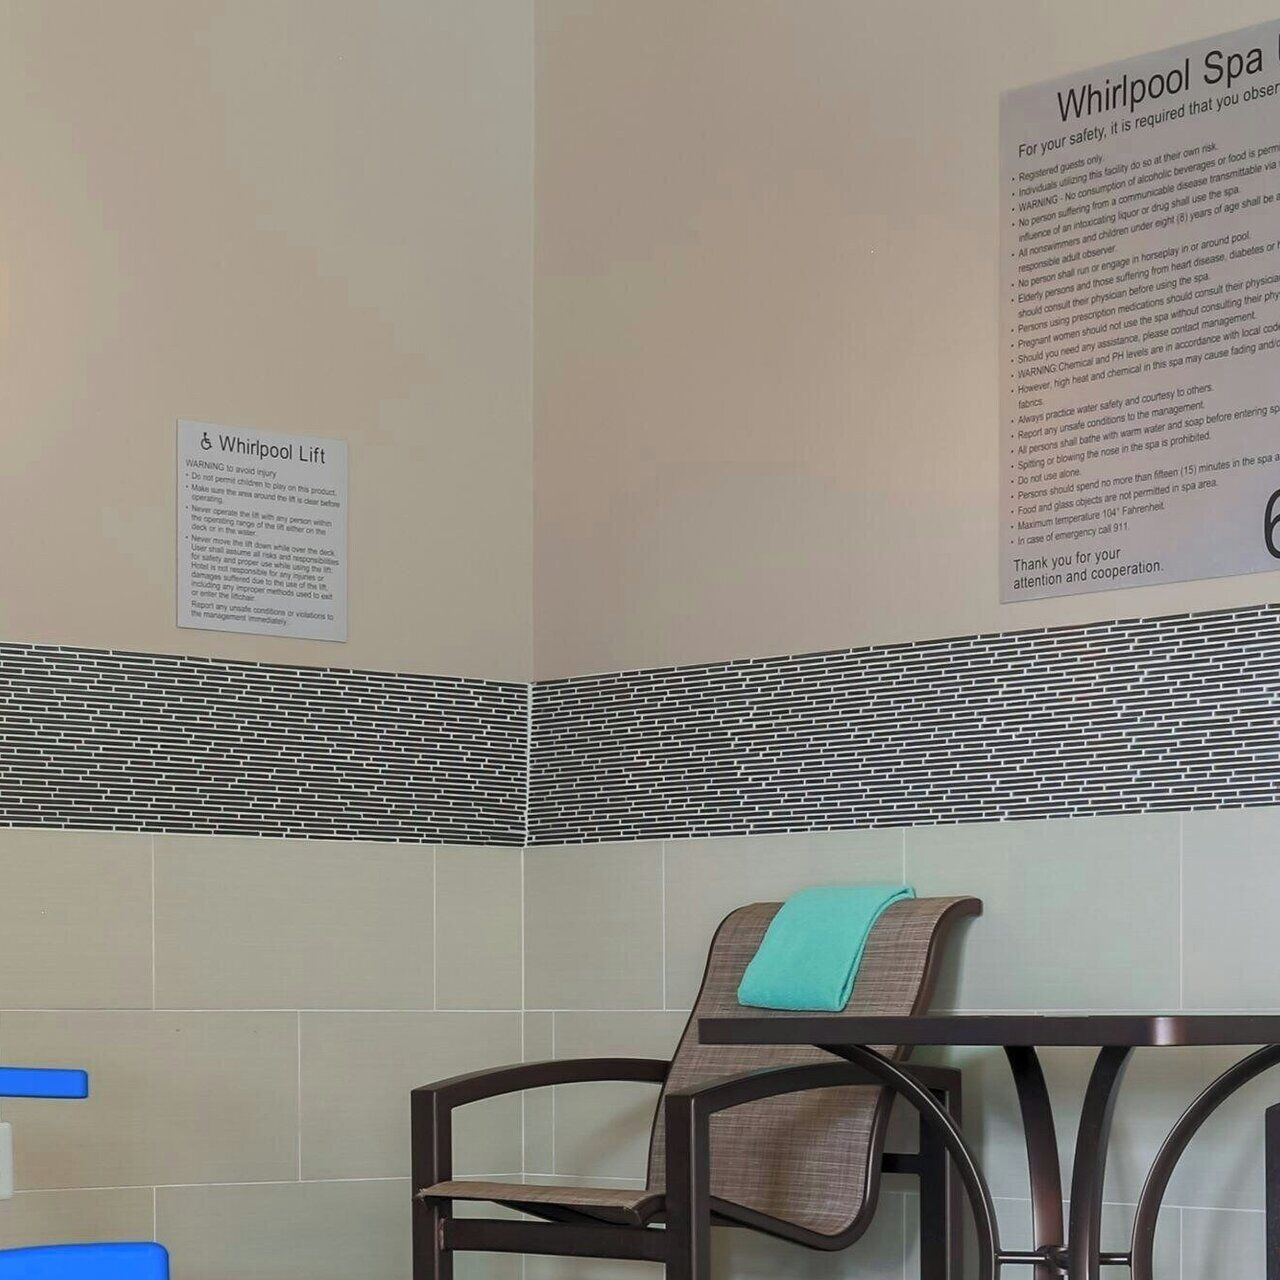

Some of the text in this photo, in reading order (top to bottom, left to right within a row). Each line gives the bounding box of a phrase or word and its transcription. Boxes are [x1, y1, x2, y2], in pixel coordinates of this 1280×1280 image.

[1058, 57, 1191, 121] Whirlpool
[1204, 48, 1262, 88] Spa
[1018, 143, 1036, 158] For
[1041, 136, 1065, 155] your
[1069, 126, 1106, 145] safety,
[1110, 121, 1117, 134] it
[1121, 118, 1130, 132] is
[1135, 103, 1184, 128] required
[1189, 97, 1212, 115] that
[1216, 93, 1238, 112] you
[219, 434, 325, 463] Whirlpool Lift
[1014, 548, 1120, 571] Thank you for your
[1013, 560, 1163, 589] attention and cooperation.
